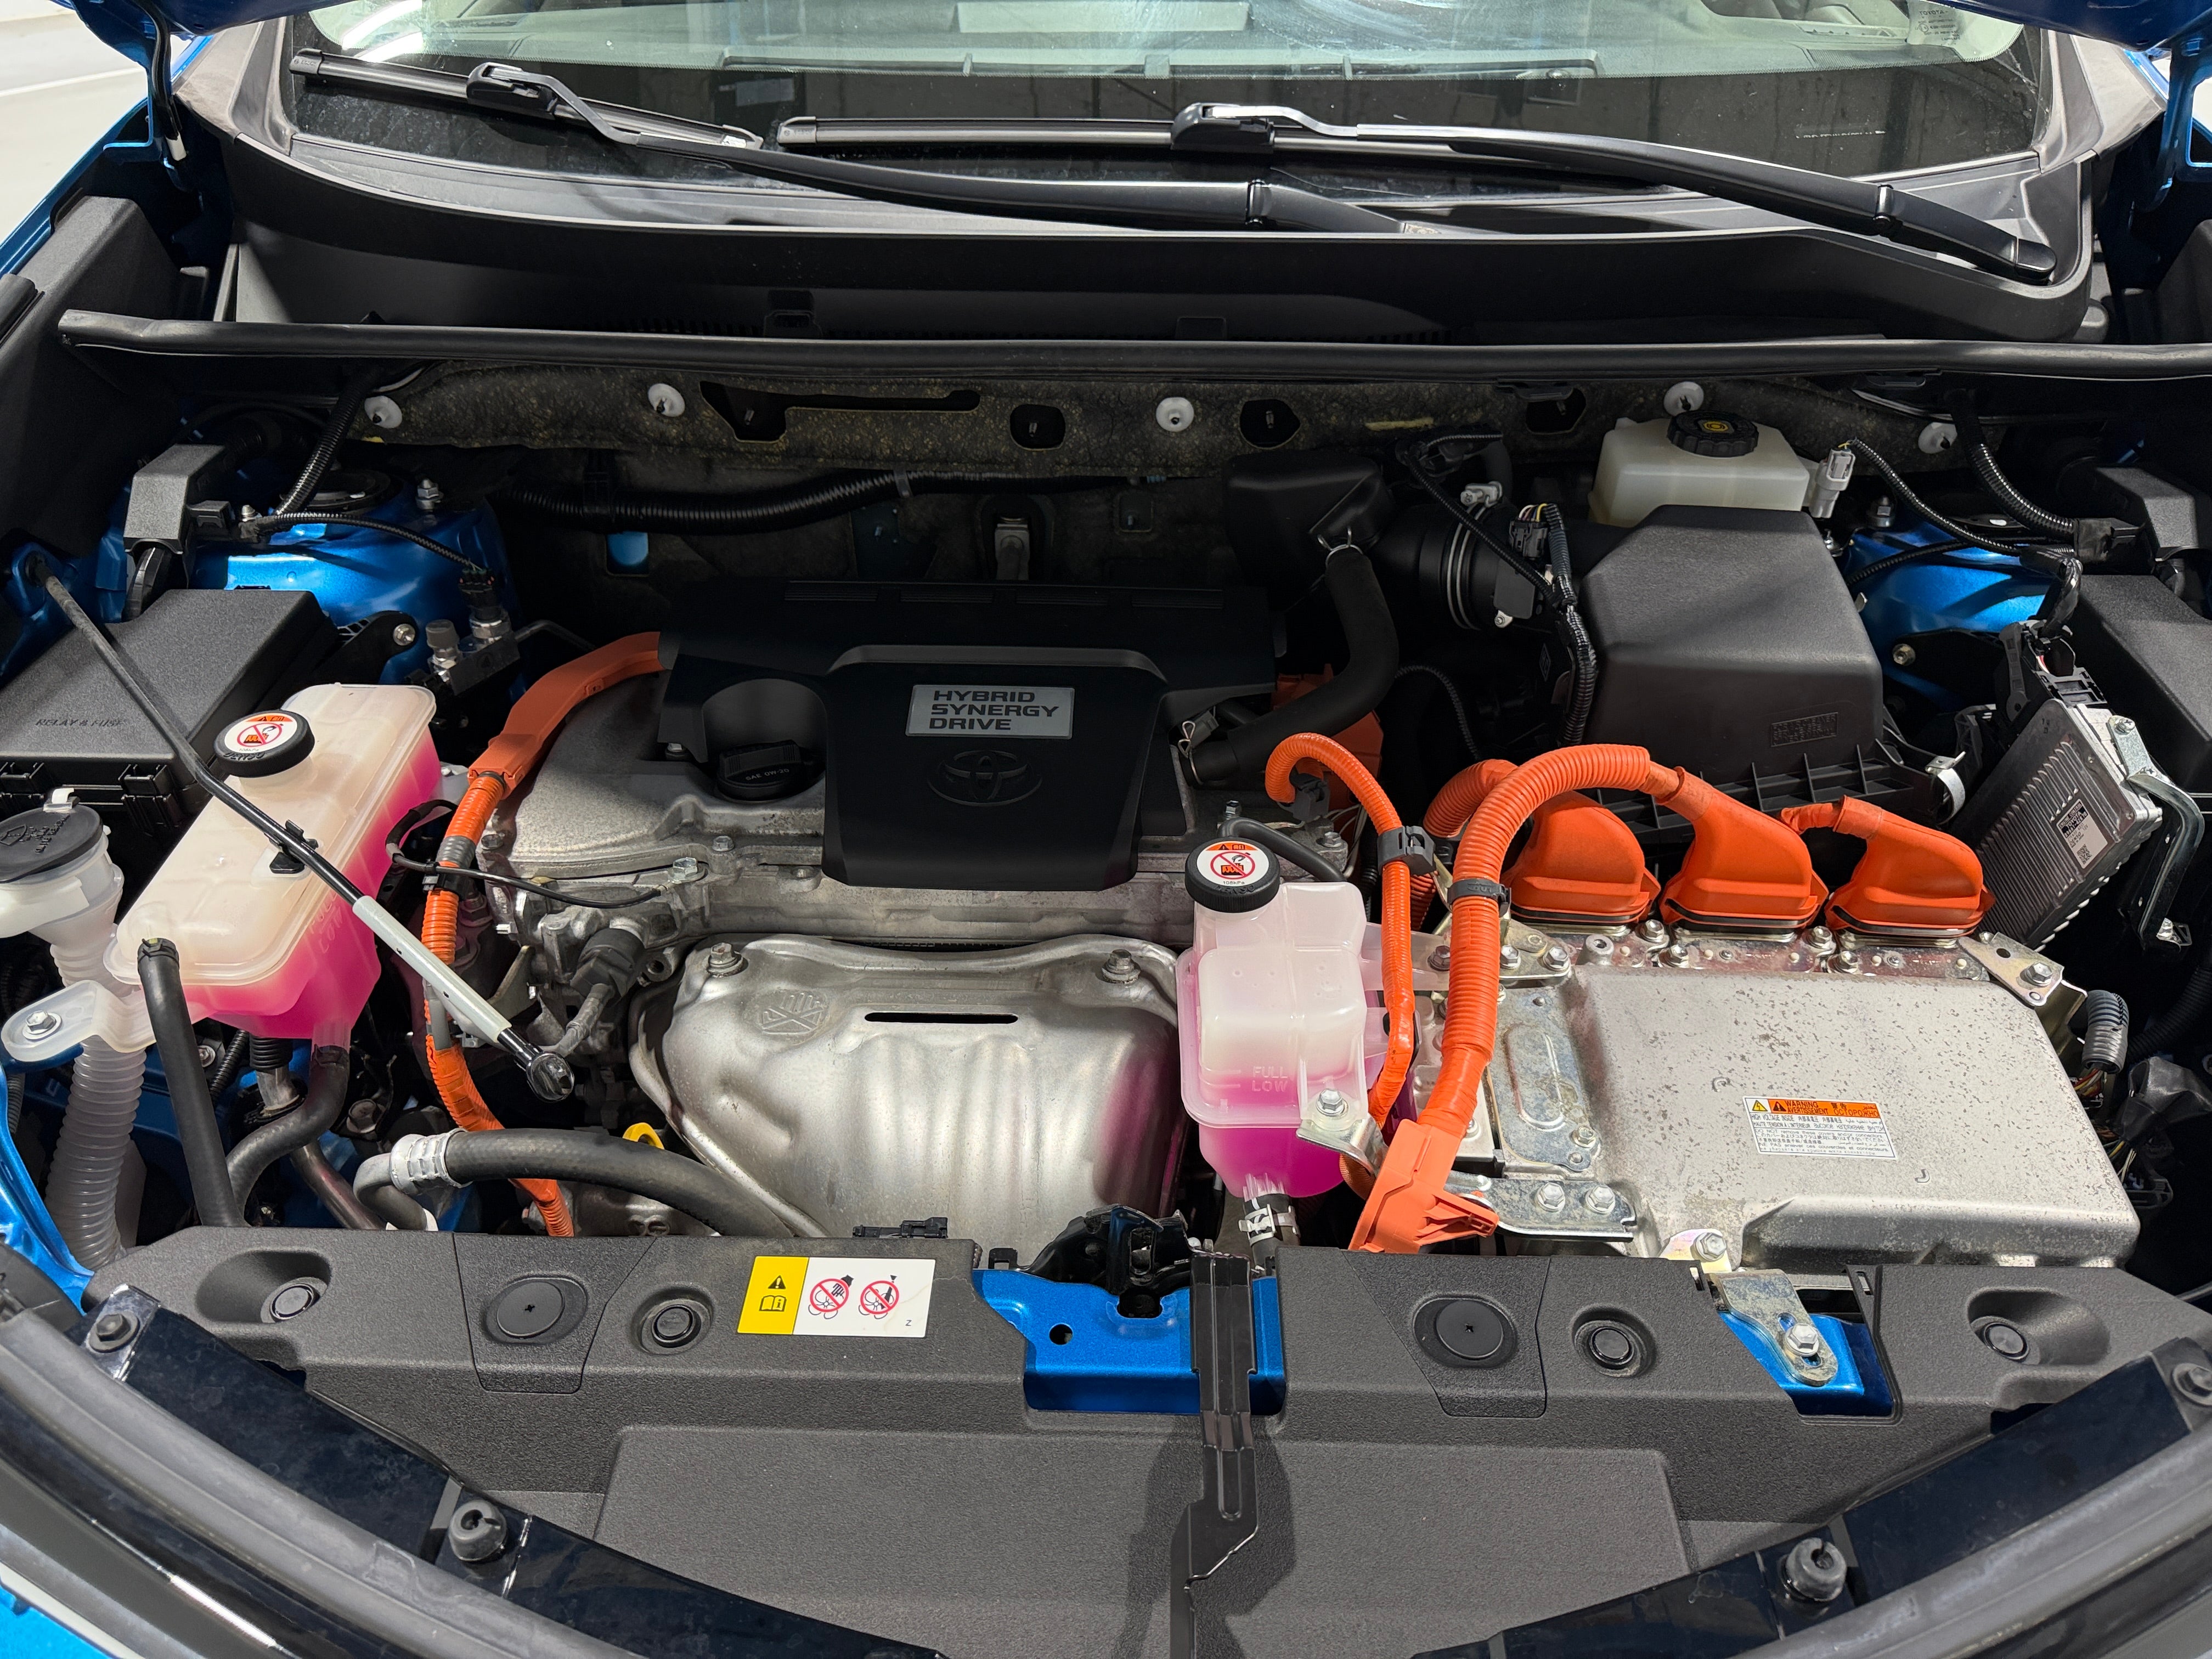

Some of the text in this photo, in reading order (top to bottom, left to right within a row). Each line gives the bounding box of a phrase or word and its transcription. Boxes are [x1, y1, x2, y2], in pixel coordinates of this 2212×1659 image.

[934, 690, 1035, 702] HYBRID
[931, 704, 1059, 717] SYNERGY
[35, 718, 79, 727] RELAY
[91, 719, 124, 727] FUSE
[929, 718, 1012, 730] DRIVE
[764, 768, 790, 776] 0W-20
[2066, 810, 2081, 829] TOYOTA
[1215, 885, 1255, 895] DENSO
[1252, 1066, 1288, 1079] FULL
[1251, 1080, 1288, 1092] LOW
